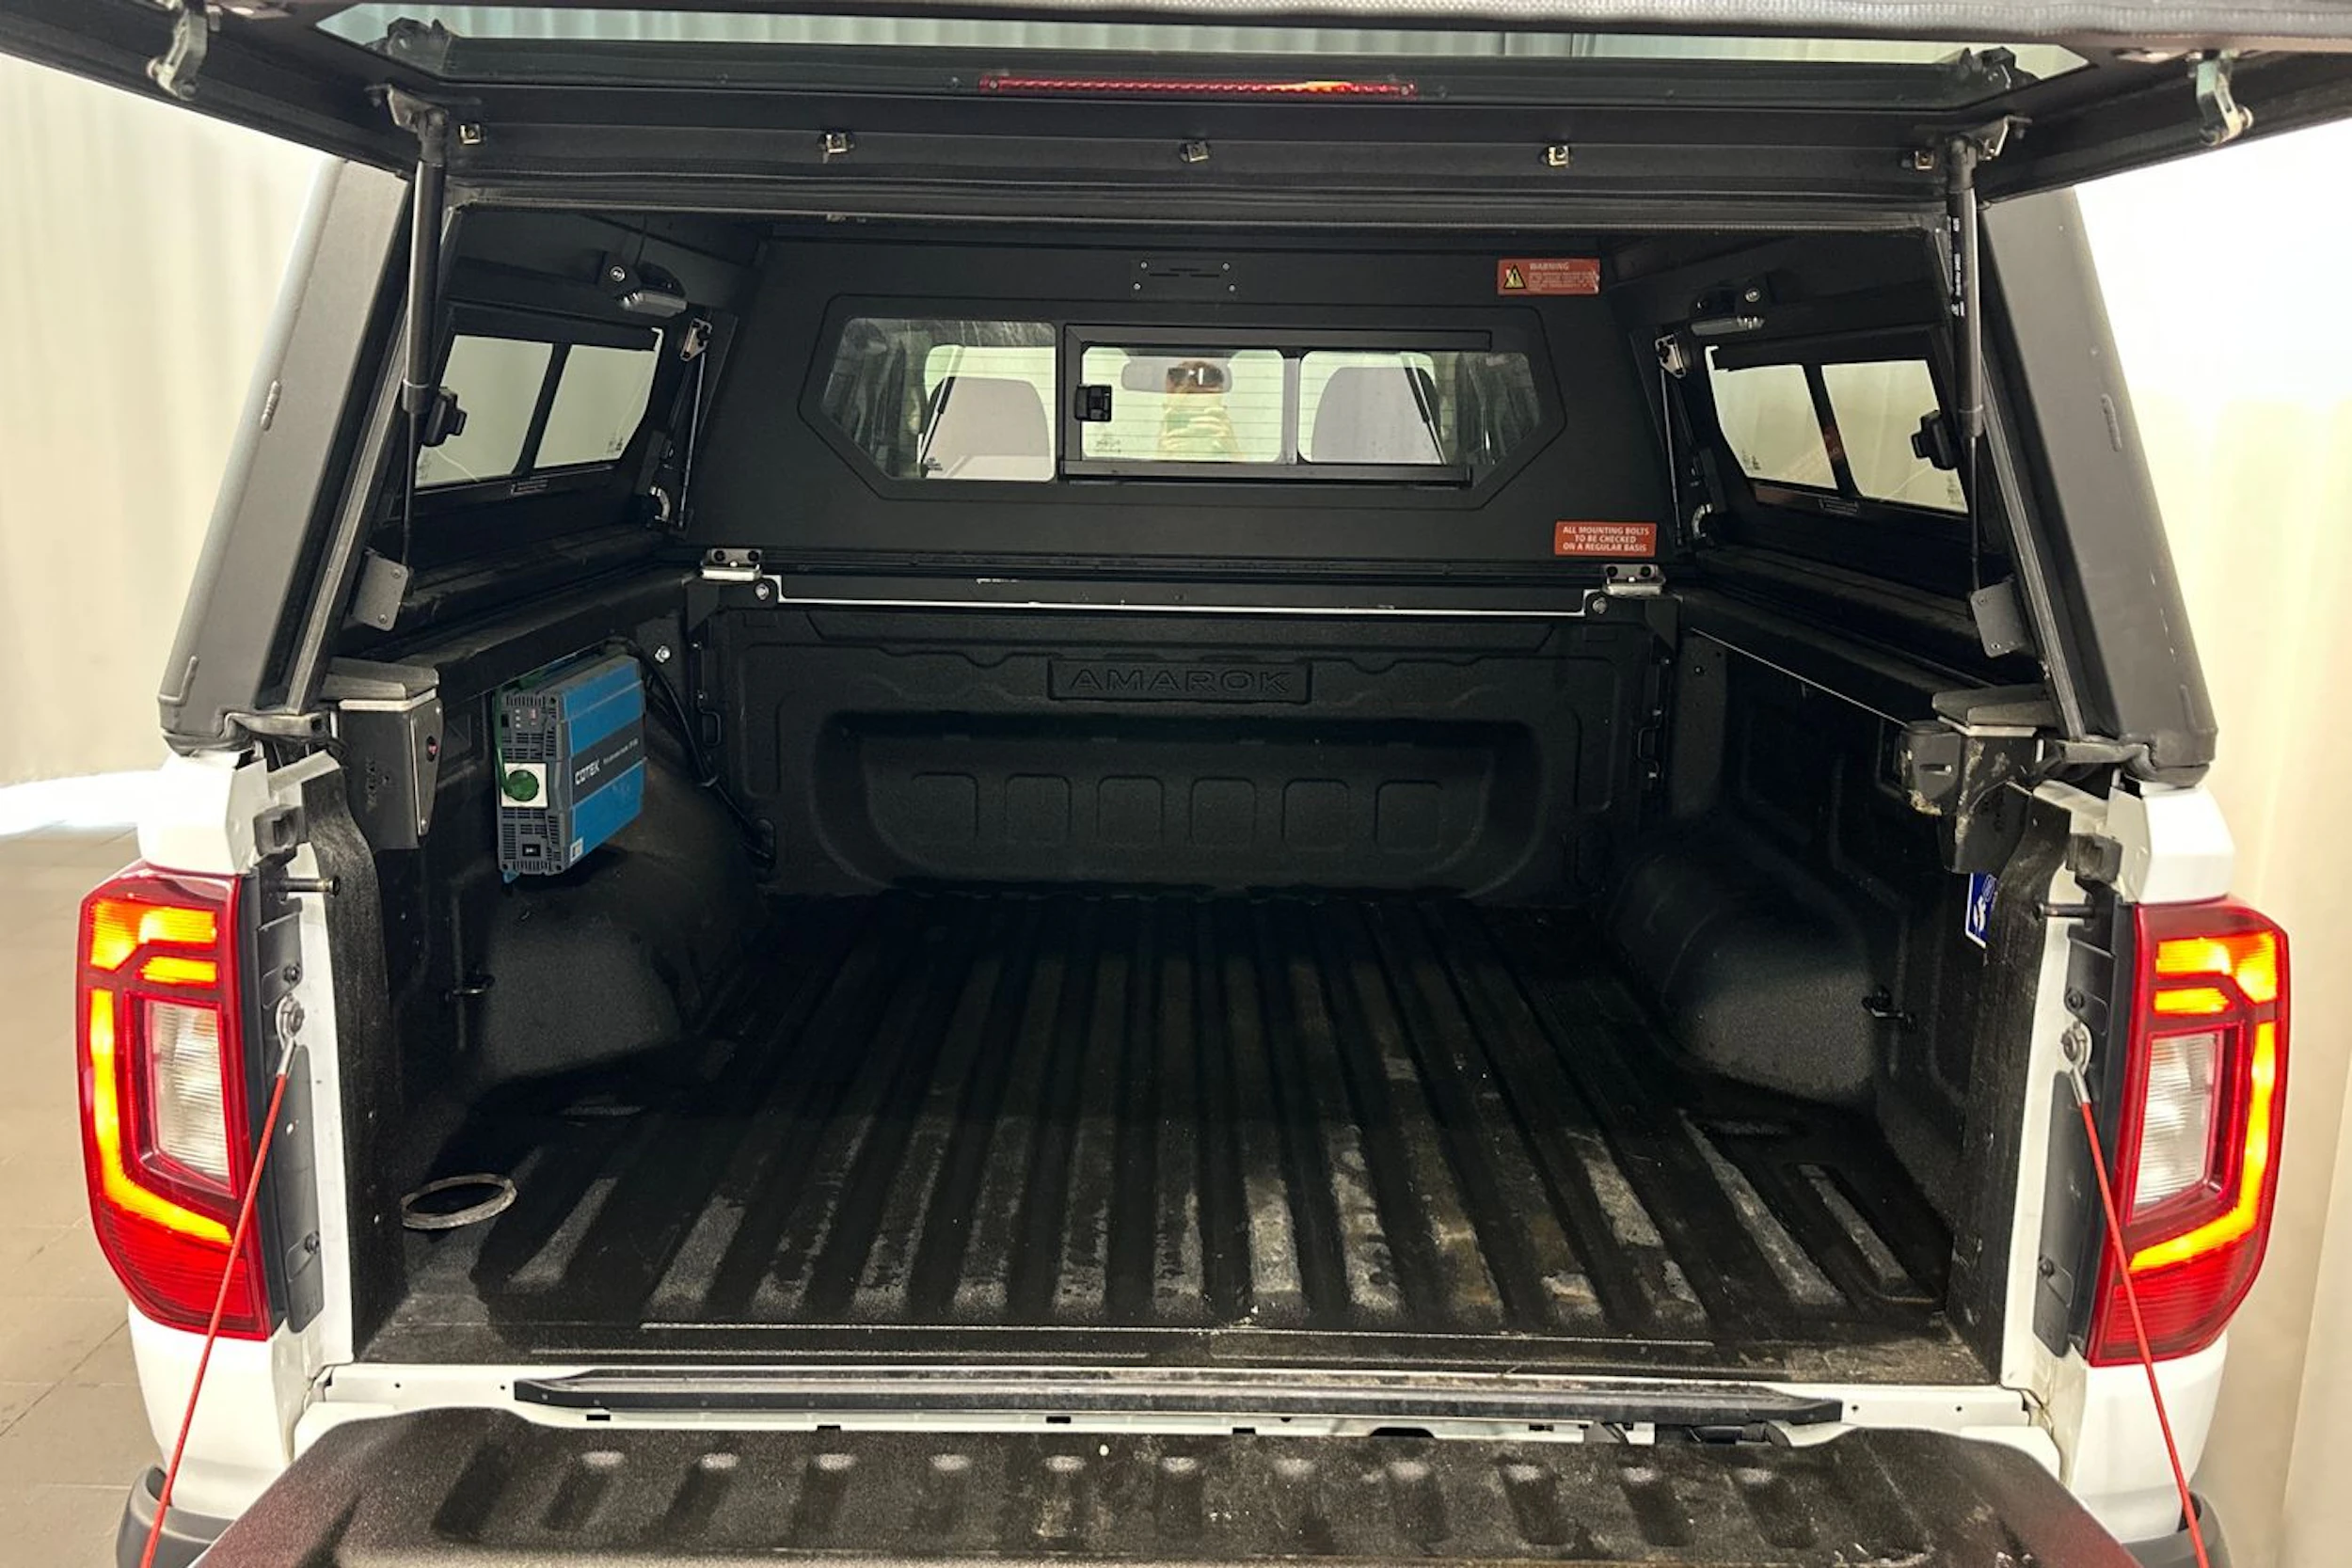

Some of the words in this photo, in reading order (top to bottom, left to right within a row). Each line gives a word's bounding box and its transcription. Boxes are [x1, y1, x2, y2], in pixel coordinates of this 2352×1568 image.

[1529, 262, 1569, 271] WARNING
[1563, 526, 1577, 534] ALL
[1578, 526, 1623, 535] MOUNTING
[1625, 527, 1650, 535] BOLTS
[1575, 534, 1585, 543] TO
[1587, 534, 1597, 543] BE
[1599, 534, 1637, 543] CHECKED
[1563, 542, 1575, 550] ON
[1584, 543, 1623, 551] REGULAR
[1624, 544, 1647, 552] BASIS
[1071, 669, 1290, 693] AMAROK
[575, 759, 600, 785] COTEK
